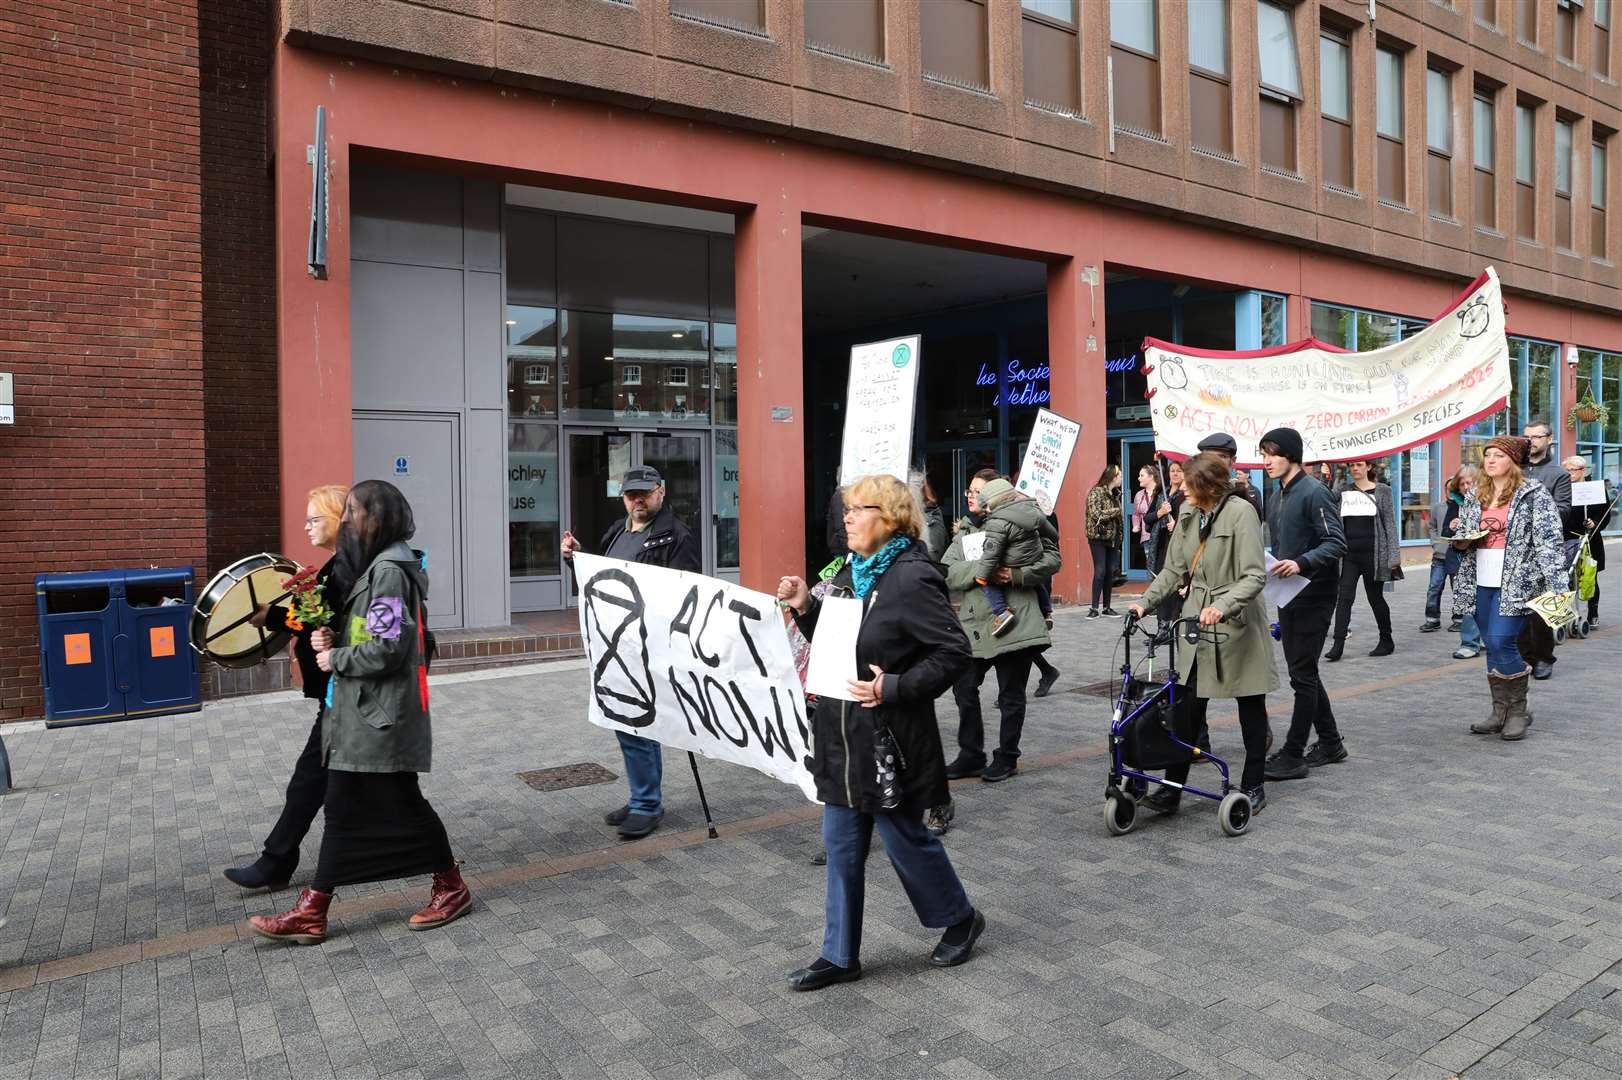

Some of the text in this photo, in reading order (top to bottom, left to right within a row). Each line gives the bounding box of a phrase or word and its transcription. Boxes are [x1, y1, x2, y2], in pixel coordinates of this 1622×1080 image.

[1007, 359, 1050, 382] Socie
[1104, 354, 1136, 372] oms
[993, 381, 1050, 406] Wethe
[1180, 406, 1217, 433] ACT
[1223, 415, 1271, 438] NOW
[1305, 411, 1343, 431] ZERO
[1348, 407, 1390, 427] CARBON
[1457, 362, 1495, 392] 2025
[1040, 415, 1058, 427] WHAT
[1329, 423, 1403, 451] ENDANGERED
[1412, 401, 1463, 428] SPECIES
[1042, 434, 1062, 449] EARTH
[1031, 450, 1060, 468] OURSELVES
[1034, 460, 1054, 473] MARCH
[723, 466, 739, 482] bre
[1032, 471, 1051, 489] LIFE
[510, 496, 536, 510] use
[669, 585, 768, 678] ACT
[669, 665, 816, 774] NOW!
